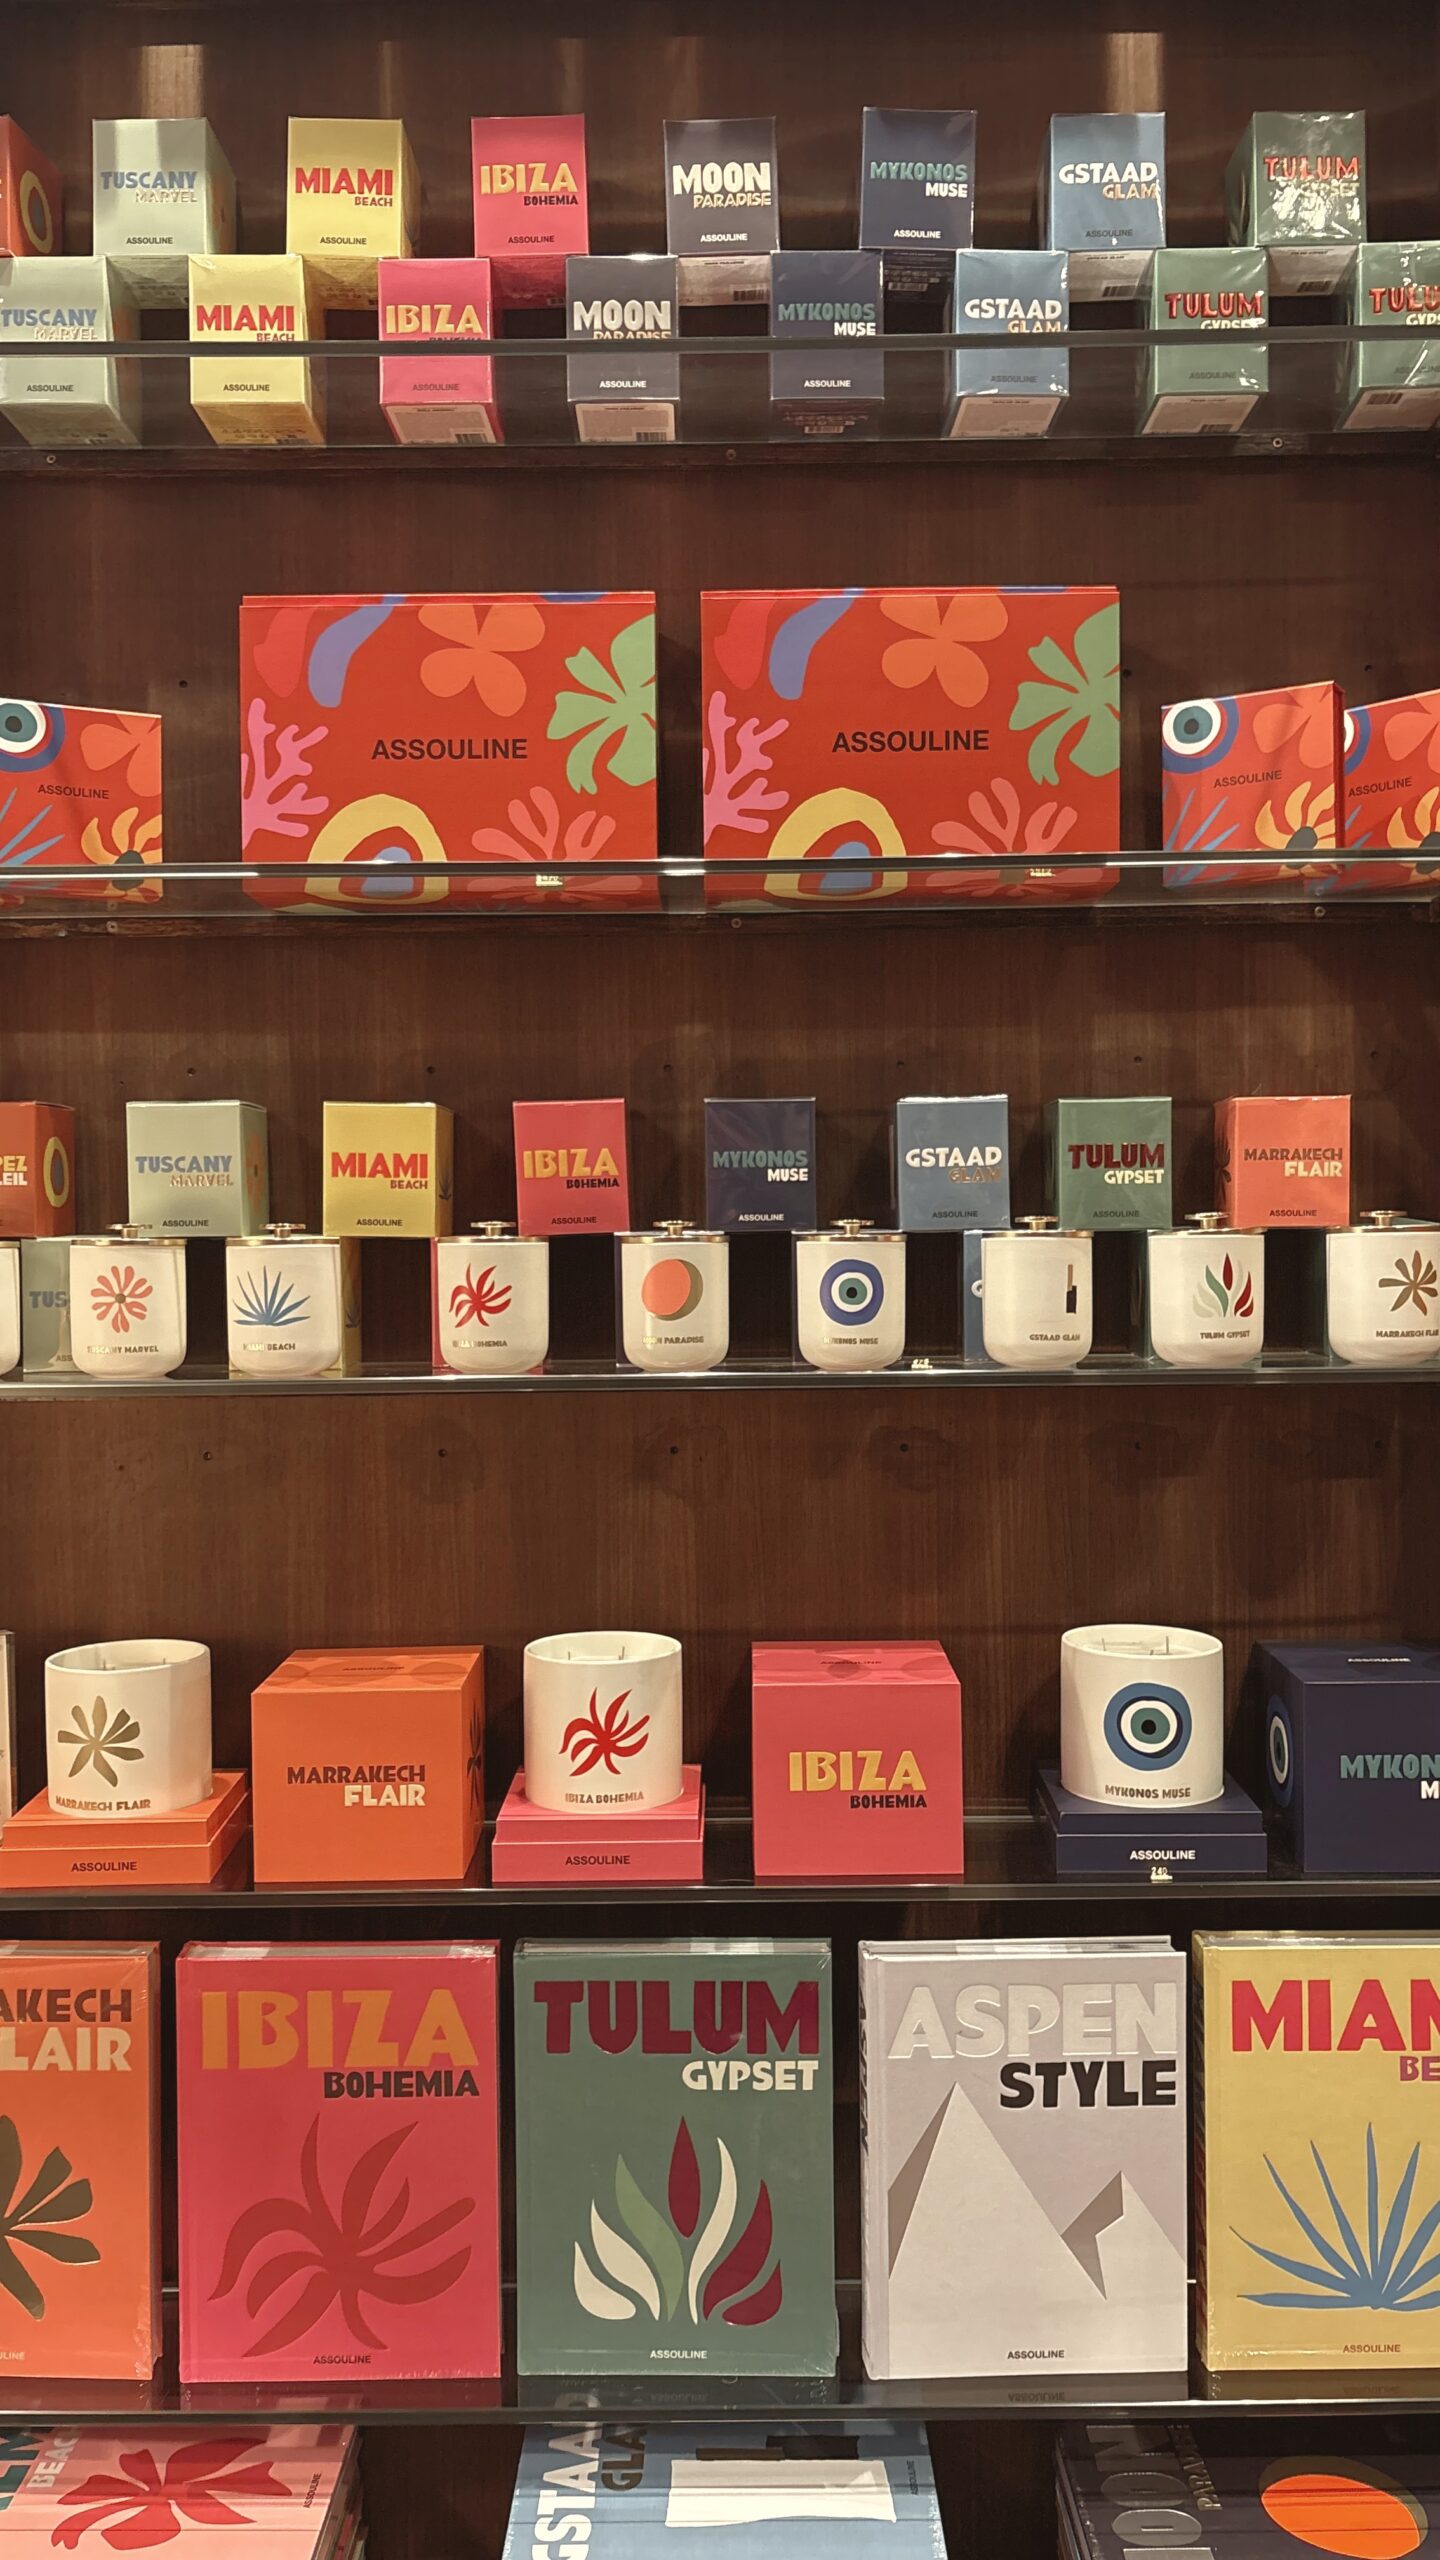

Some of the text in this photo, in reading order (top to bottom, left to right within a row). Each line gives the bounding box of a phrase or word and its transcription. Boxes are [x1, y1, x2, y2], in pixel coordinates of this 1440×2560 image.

[870, 161, 968, 182] MYKONOS
[1058, 162, 1157, 184] GSTAAD
[1264, 155, 1359, 181] TULUM
[100, 171, 198, 189] TUSCANY
[295, 167, 394, 195] MIAMI
[480, 163, 578, 195] IBIZA
[672, 162, 771, 195] MOON
[135, 189, 198, 203] MARVEL
[925, 182, 968, 197] MUSE
[1102, 183, 1157, 200] GLAM
[354, 196, 393, 207] BEACH
[523, 194, 579, 207] BOHEMIA
[693, 192, 772, 209] PARADISE
[126, 236, 173, 245] ASSOULINE
[319, 236, 367, 245] ASSOULINE
[508, 235, 555, 244] ASSOULINE
[700, 233, 747, 242] ASSOULINE
[893, 229, 941, 239] ASSOULINE
[1085, 228, 1133, 238] ASSOULINE
[778, 303, 875, 321] MYKONOS
[965, 299, 1062, 319] GSTAAD
[1165, 292, 1263, 319] TULUM
[1, 309, 97, 327] TUSCANY
[196, 305, 295, 331] MIAMI
[386, 304, 483, 334] IBIZA
[573, 299, 671, 331] MOON
[34, 326, 98, 340] MARVEL
[834, 322, 876, 337] MUSE
[1008, 320, 1061, 333] GLAM
[256, 333, 296, 342] BEACH
[26, 384, 74, 392] ASSOULINE
[223, 384, 270, 392] ASSOULINE
[412, 383, 460, 392] ASSOULINE
[599, 380, 647, 388] ASSOULINE
[804, 380, 851, 388] ASSOULINE
[832, 730, 989, 752] ASSOULINE
[372, 739, 528, 760] ASSOULINE
[1213, 769, 1282, 788] ASSOULINE
[38, 784, 110, 799] ASSOULINE
[1348, 776, 1412, 797] ASSOULINE
[713, 1150, 808, 1169] MYKONOS
[905, 1146, 1002, 1168] GSTAAD
[1068, 1143, 1165, 1169] TULUM
[1244, 1148, 1343, 1161] MARRAKECH
[135, 1155, 232, 1173] TUSCANY
[331, 1151, 428, 1179] MIAMI
[523, 1148, 619, 1179] IBIZA
[1284, 1161, 1343, 1178] FLAIR
[170, 1173, 233, 1187] MARVEL
[767, 1168, 809, 1182] MUSE
[948, 1167, 1001, 1184] GLAM
[1104, 1169, 1165, 1185] GYPSET
[390, 1179, 428, 1190] BEACH
[566, 1178, 620, 1190] BOHEMIA
[551, 1216, 597, 1225] ASSOULINE
[738, 1214, 785, 1222] ASSOULINE
[932, 1210, 978, 1218] ASSOULINE
[1092, 1210, 1140, 1218] ASSOULINE
[1269, 1209, 1317, 1217] ASSOULINE
[162, 1219, 209, 1227] ASSOULINE
[356, 1219, 403, 1227] ASSOULINE
[267, 1343, 296, 1351] BEACH
[664, 1336, 704, 1344] PARADISE
[124, 1345, 159, 1353] MARVEL
[287, 1764, 425, 1784] MARRAKECH
[789, 1750, 927, 1792] IBIZA
[344, 1783, 426, 1807] FLAIR
[565, 1791, 645, 1804] IBIZA BOHEMIA
[1105, 1785, 1191, 1799] MYKONOS MUSE
[56, 1795, 151, 1812] MARRAKECH FLAIR
[850, 1794, 927, 1809] BOHEMIA
[565, 1855, 631, 1866] ASSOULINE
[1130, 1850, 1196, 1860] ASSOULINE
[71, 1861, 137, 1873] ASSOULINE
[534, 1980, 819, 2055] TULUM
[887, 1982, 1178, 2059] ASPEN
[201, 1988, 479, 2070] IBIZA
[681, 2060, 819, 2091] GYPSET
[323, 2070, 480, 2099] BOHEMIA
[999, 2059, 1177, 2109] STYLE
[650, 2350, 708, 2359] ASSOULINE
[1007, 2350, 1065, 2359] ASSOULINE
[1343, 2344, 1401, 2353] ASSOULINE
[313, 2355, 371, 2364] ASSOULINE
